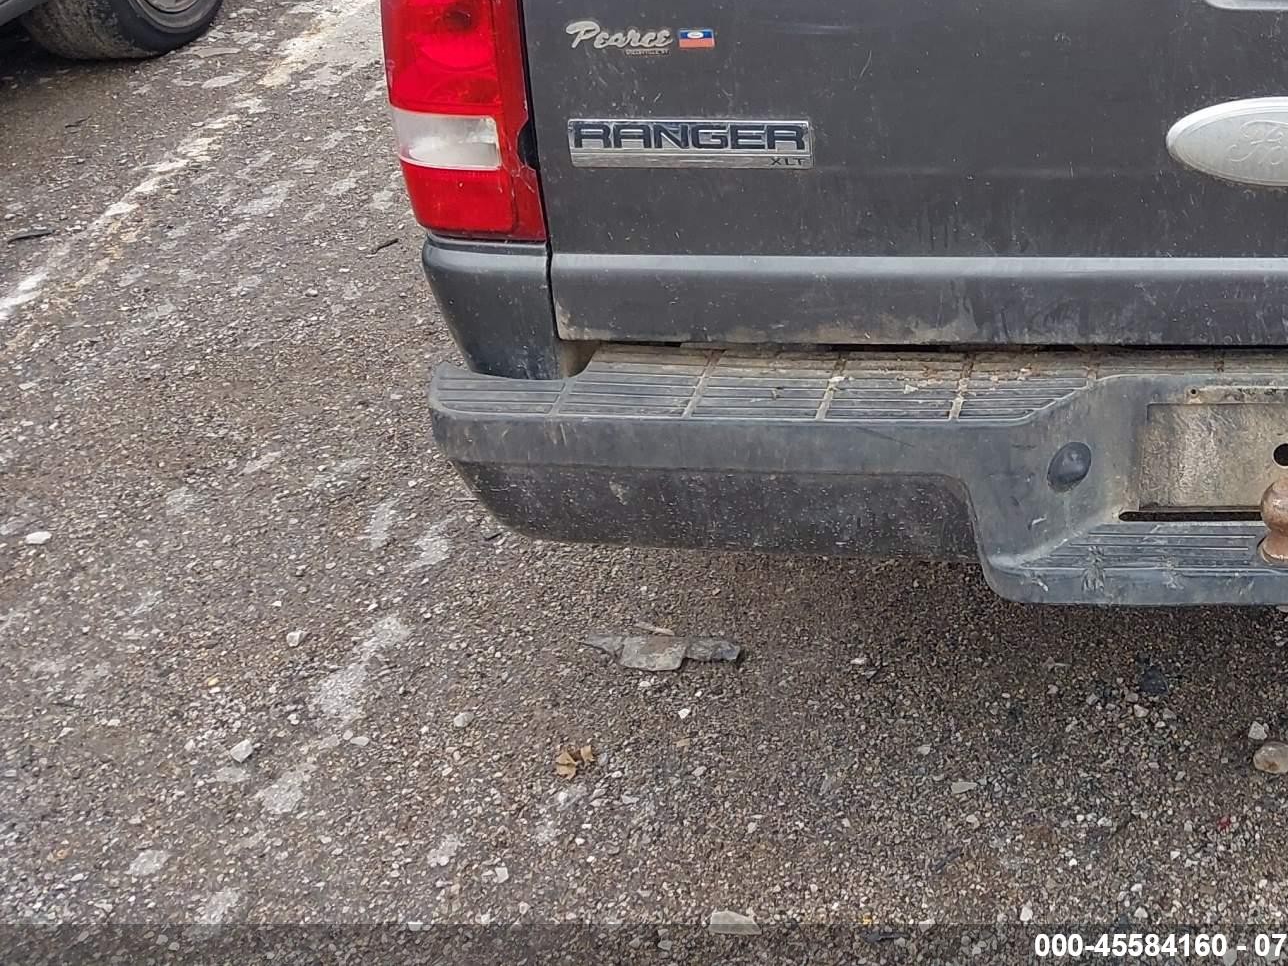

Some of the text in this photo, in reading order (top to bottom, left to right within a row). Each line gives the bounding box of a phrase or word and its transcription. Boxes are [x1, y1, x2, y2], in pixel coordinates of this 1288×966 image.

[565, 20, 673, 49] Pearce
[573, 123, 806, 150] RANGER
[770, 157, 806, 166] XLT
